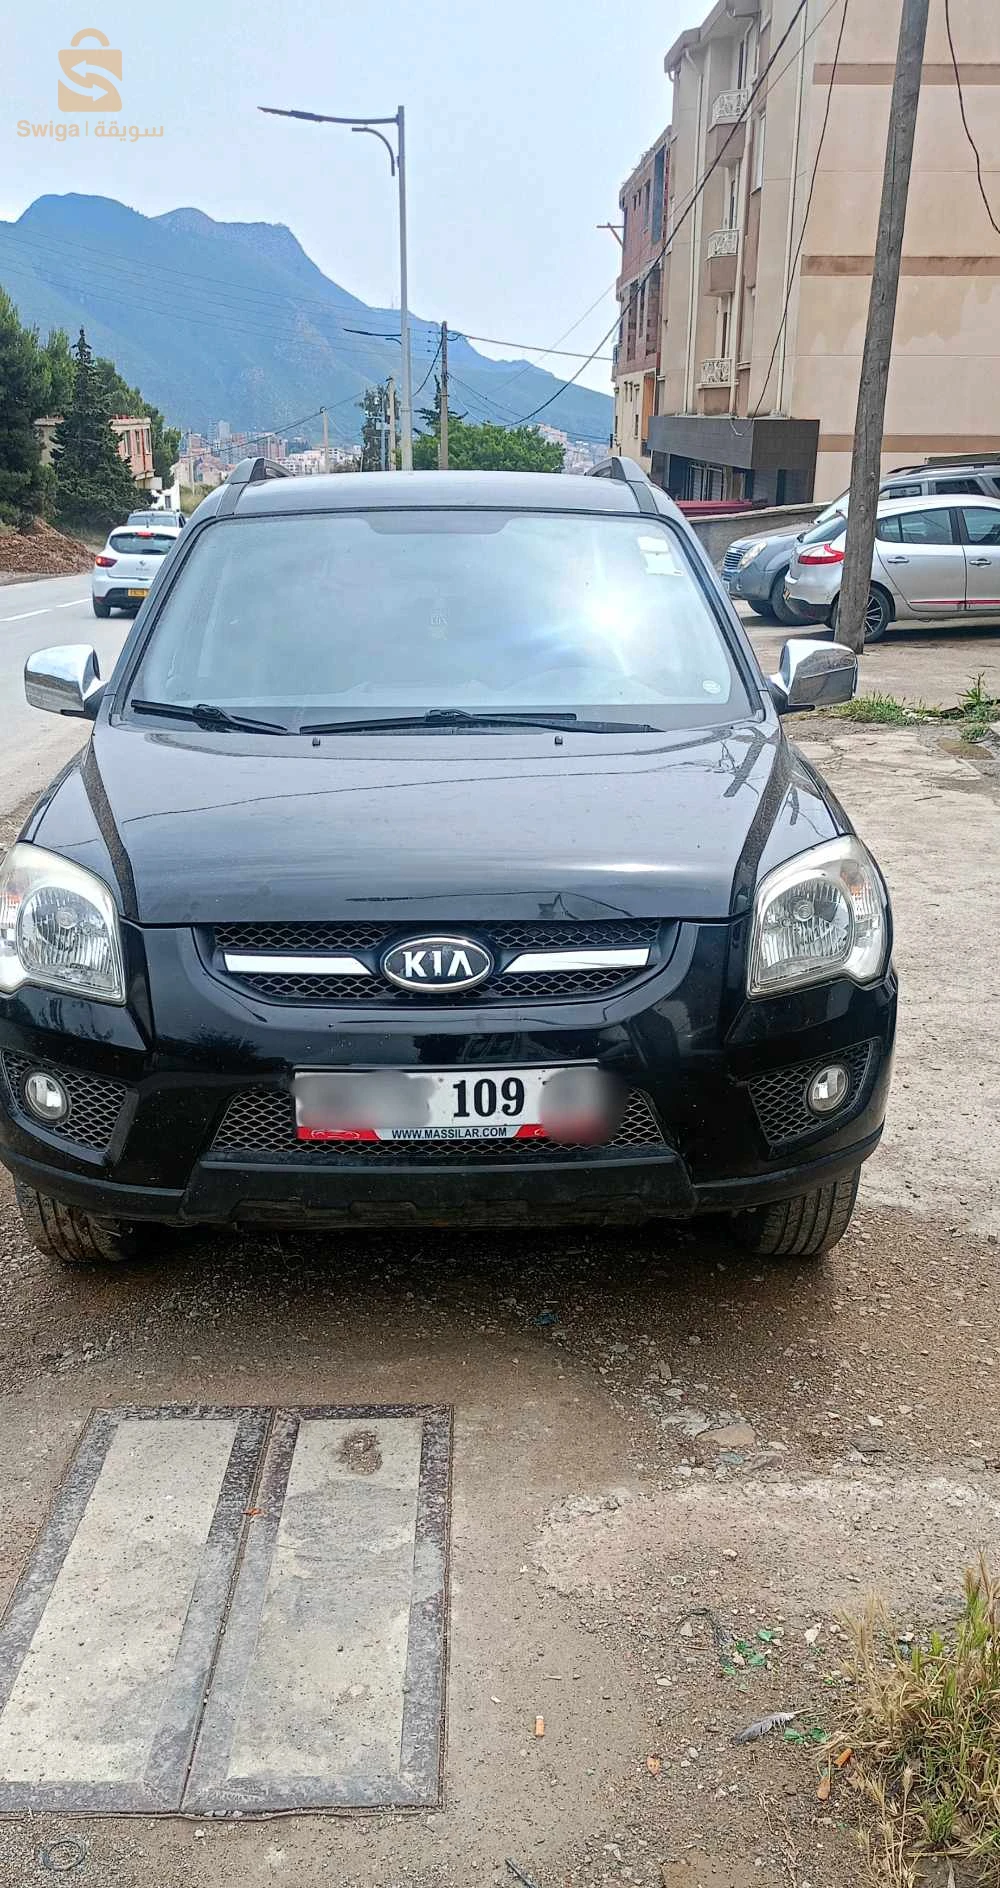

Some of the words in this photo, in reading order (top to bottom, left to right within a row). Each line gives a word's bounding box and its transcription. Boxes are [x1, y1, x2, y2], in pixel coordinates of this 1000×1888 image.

[403, 950, 473, 977] KIA
[453, 1077, 525, 1117] 109
[392, 1127, 507, 1139] WWW.MASSILAR.COM
